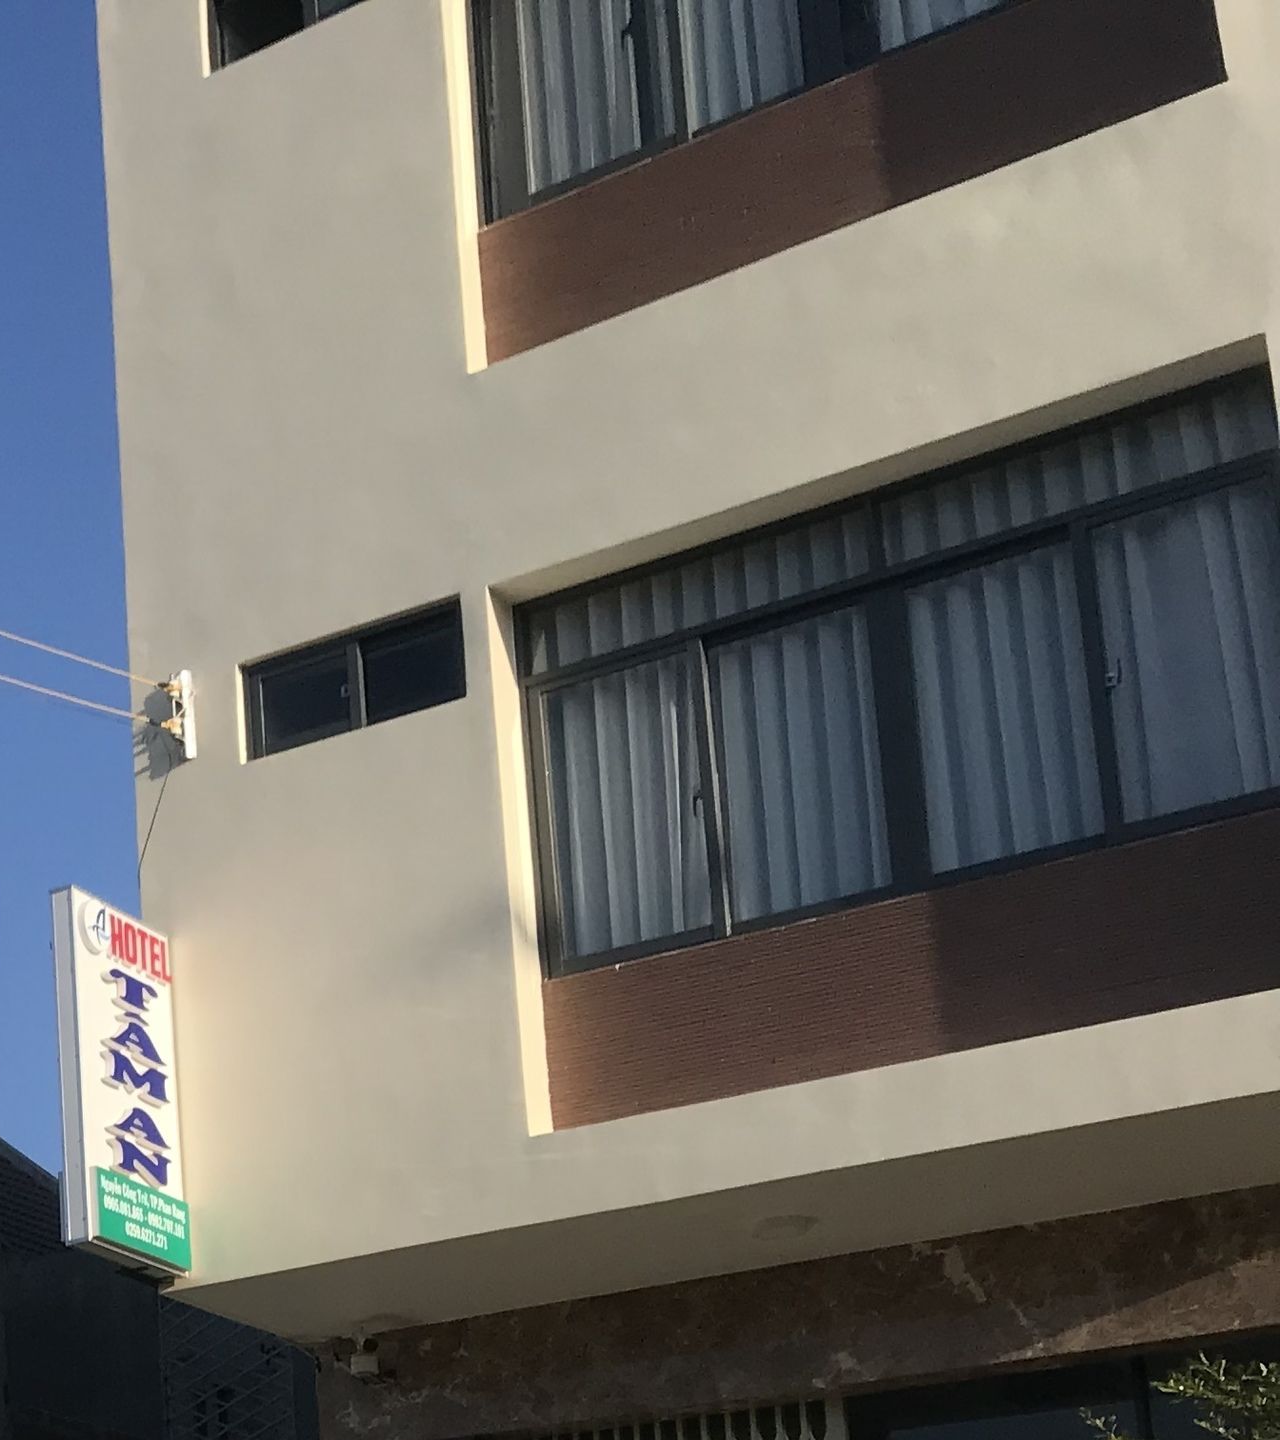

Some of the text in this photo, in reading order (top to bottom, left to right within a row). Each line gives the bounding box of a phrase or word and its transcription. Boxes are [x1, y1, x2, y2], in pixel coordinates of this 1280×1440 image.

[110, 913, 172, 984] HOTEL
[108, 968, 172, 1187] TÂM AN
